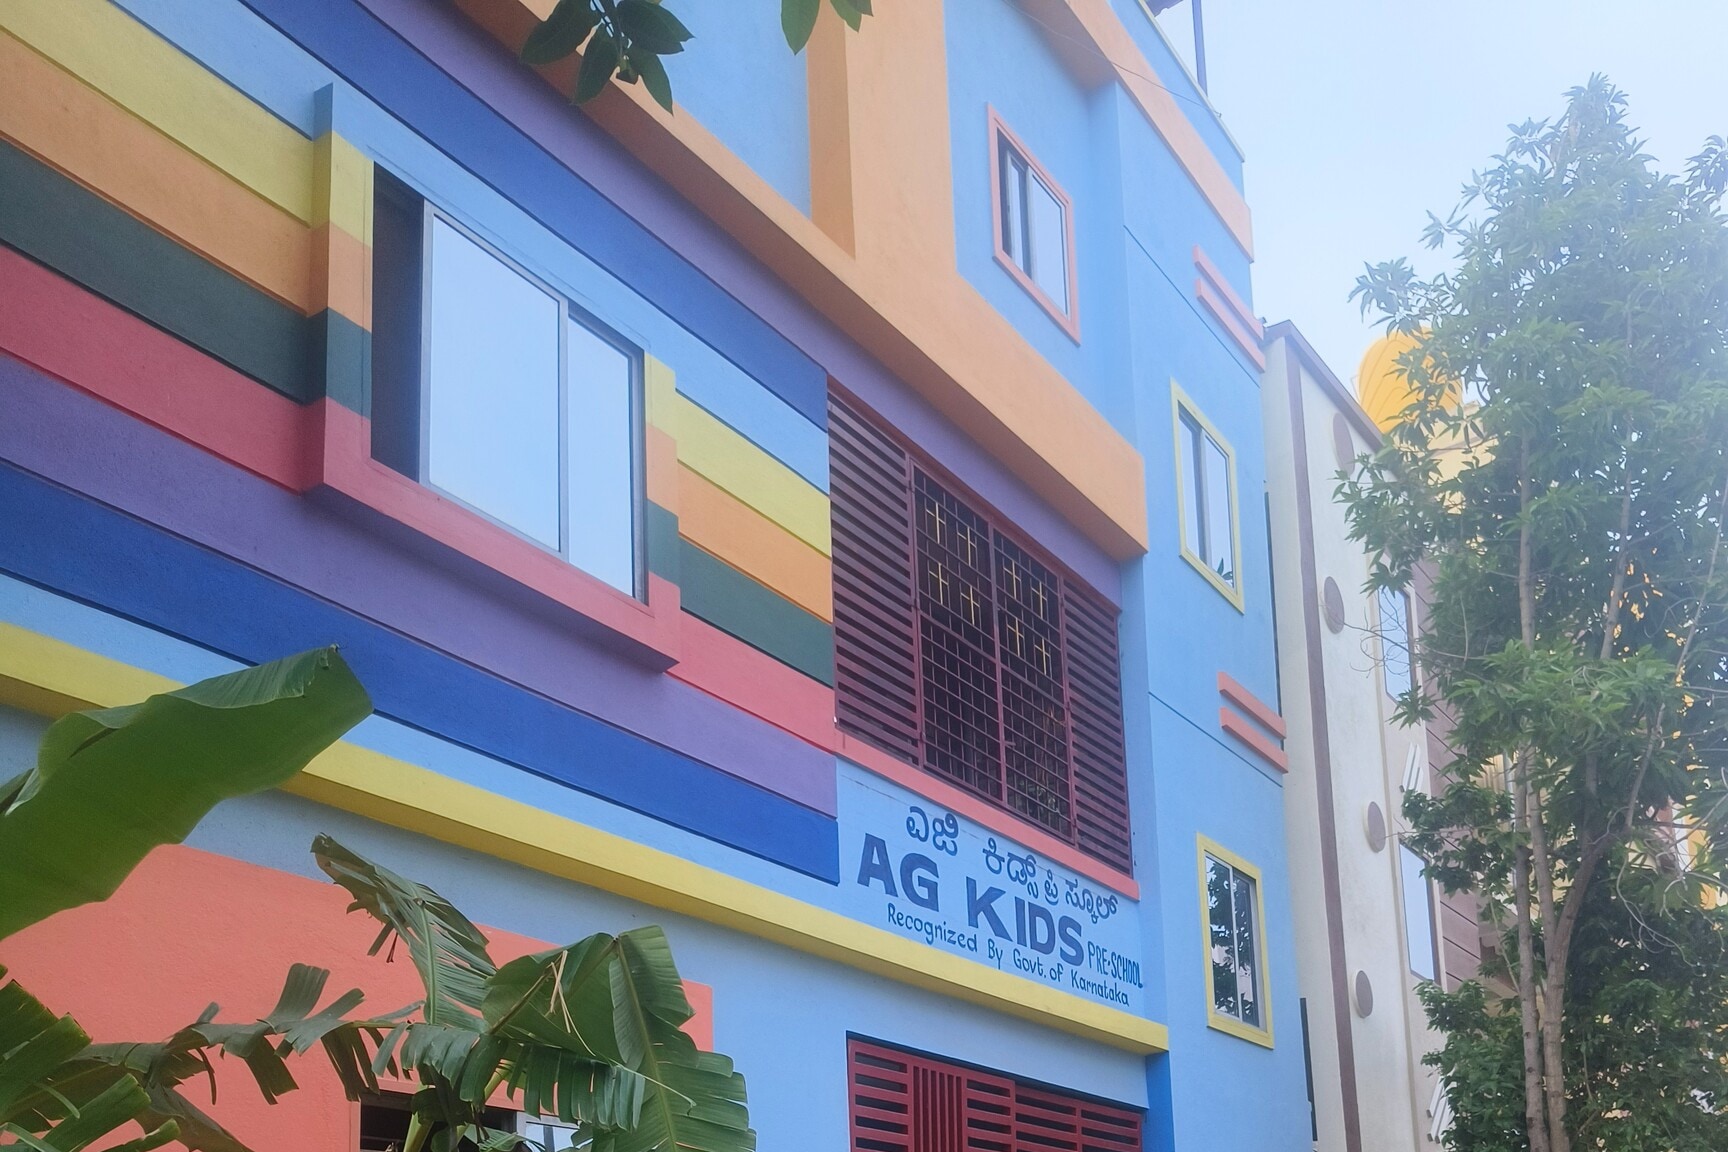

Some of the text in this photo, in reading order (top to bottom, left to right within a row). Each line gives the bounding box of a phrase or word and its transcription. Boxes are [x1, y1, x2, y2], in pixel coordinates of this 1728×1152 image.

[857, 833, 939, 911] AG
[966, 876, 1084, 966] KIDS
[888, 903, 1129, 1006] Recognized By Govt. of Karnataka
